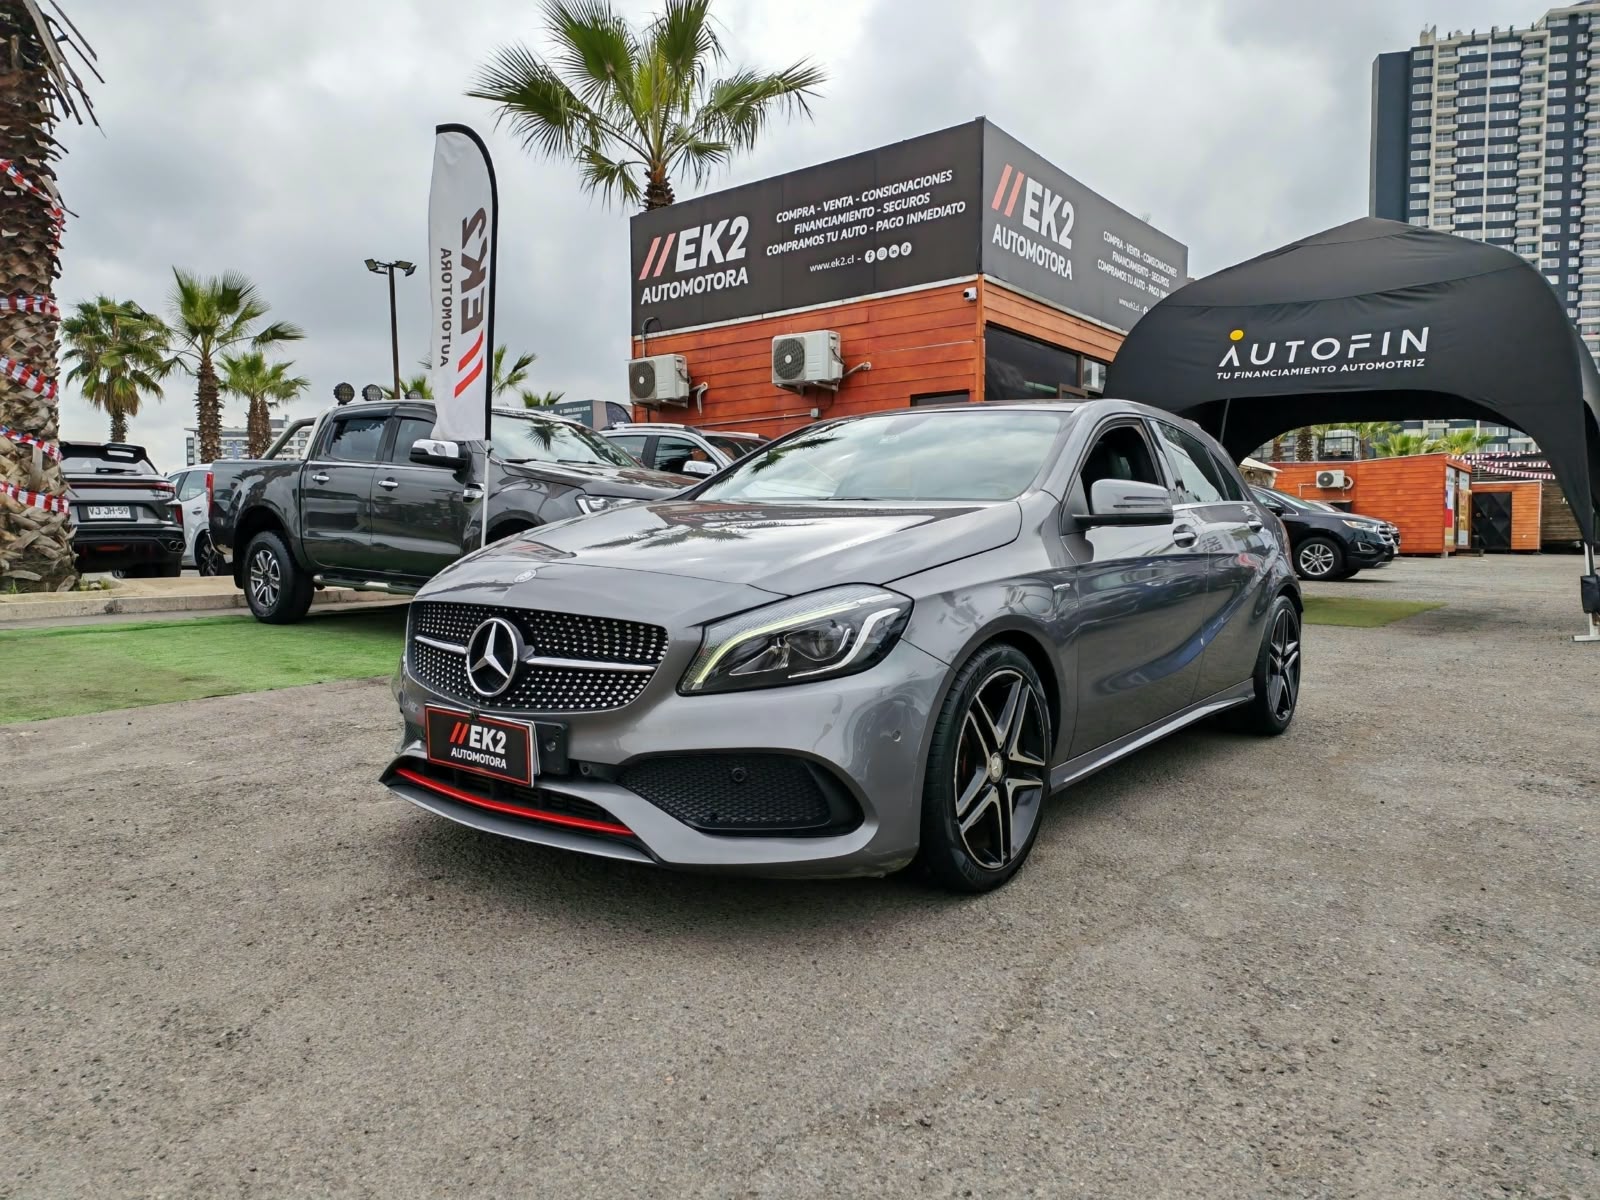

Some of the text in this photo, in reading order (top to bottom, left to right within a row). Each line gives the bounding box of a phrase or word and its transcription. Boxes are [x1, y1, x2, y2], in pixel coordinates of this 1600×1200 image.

[776, 205, 816, 223] COMPRA
[823, 195, 853, 211] VENTA
[861, 169, 953, 202] CONSIGNACIONES
[794, 206, 875, 235] FINANCIAMIENTO
[883, 192, 931, 214] SEGUROS
[766, 234, 825, 256] COMPRAMOS
[827, 231, 839, 243] TU
[840, 224, 868, 240] AUTO
[876, 216, 904, 232] PAGO
[906, 201, 966, 225] INMEDIATO
[1103, 231, 1124, 250] COMPRA
[1126, 243, 1140, 259] VENTA
[809, 254, 855, 272] www.ek2.cl
[992, 223, 1073, 280] AUTOMOTORA
[1112, 250, 1170, 288] FINANCIAMIENTO SEGUROS
[640, 266, 749, 305] AUTOMOTORA
[1097, 259, 1127, 282] COMPRAMOS
[1127, 273, 1134, 285] TU
[1133, 277, 1146, 291] AUTO
[1148, 284, 1160, 297] PAGO
[1219, 326, 1430, 368] AUTOFIN
[1216, 358, 1426, 380] TU FINANCIAMIENTO AUTOMOTRIZ
[450, 747, 507, 770] AUTOMOTORA
